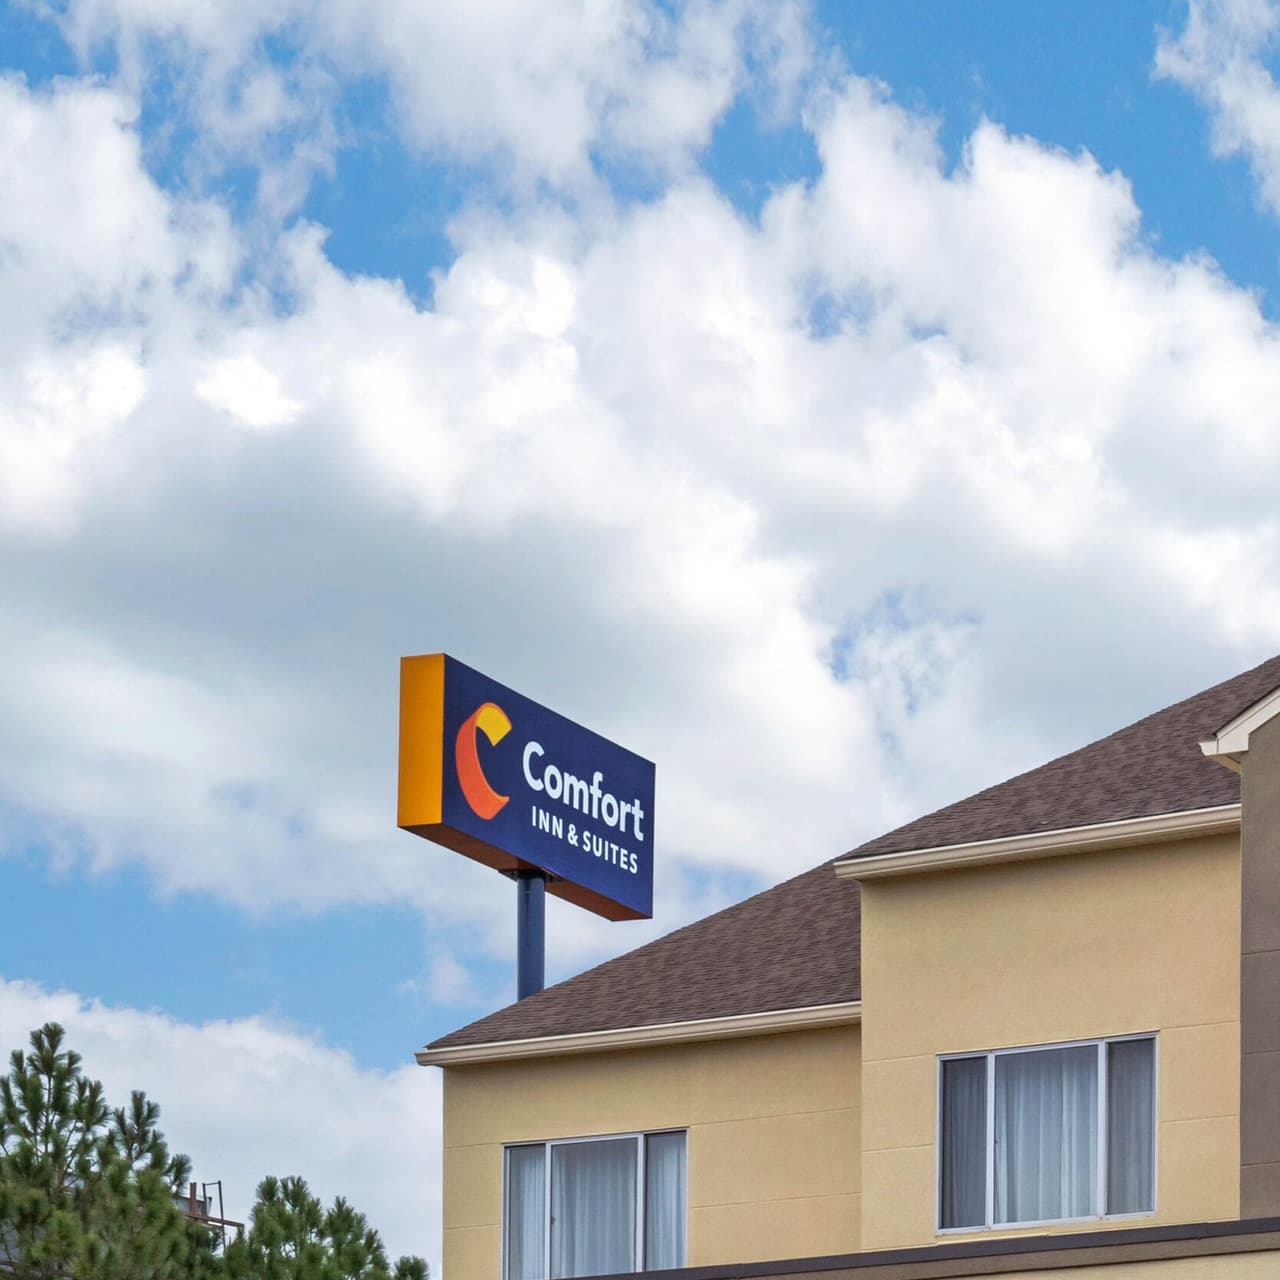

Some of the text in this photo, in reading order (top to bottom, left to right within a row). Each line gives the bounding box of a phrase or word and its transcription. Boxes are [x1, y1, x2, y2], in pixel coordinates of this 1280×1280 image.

[522, 741, 644, 841] Comfort
[532, 805, 638, 874] INN & SUITES
